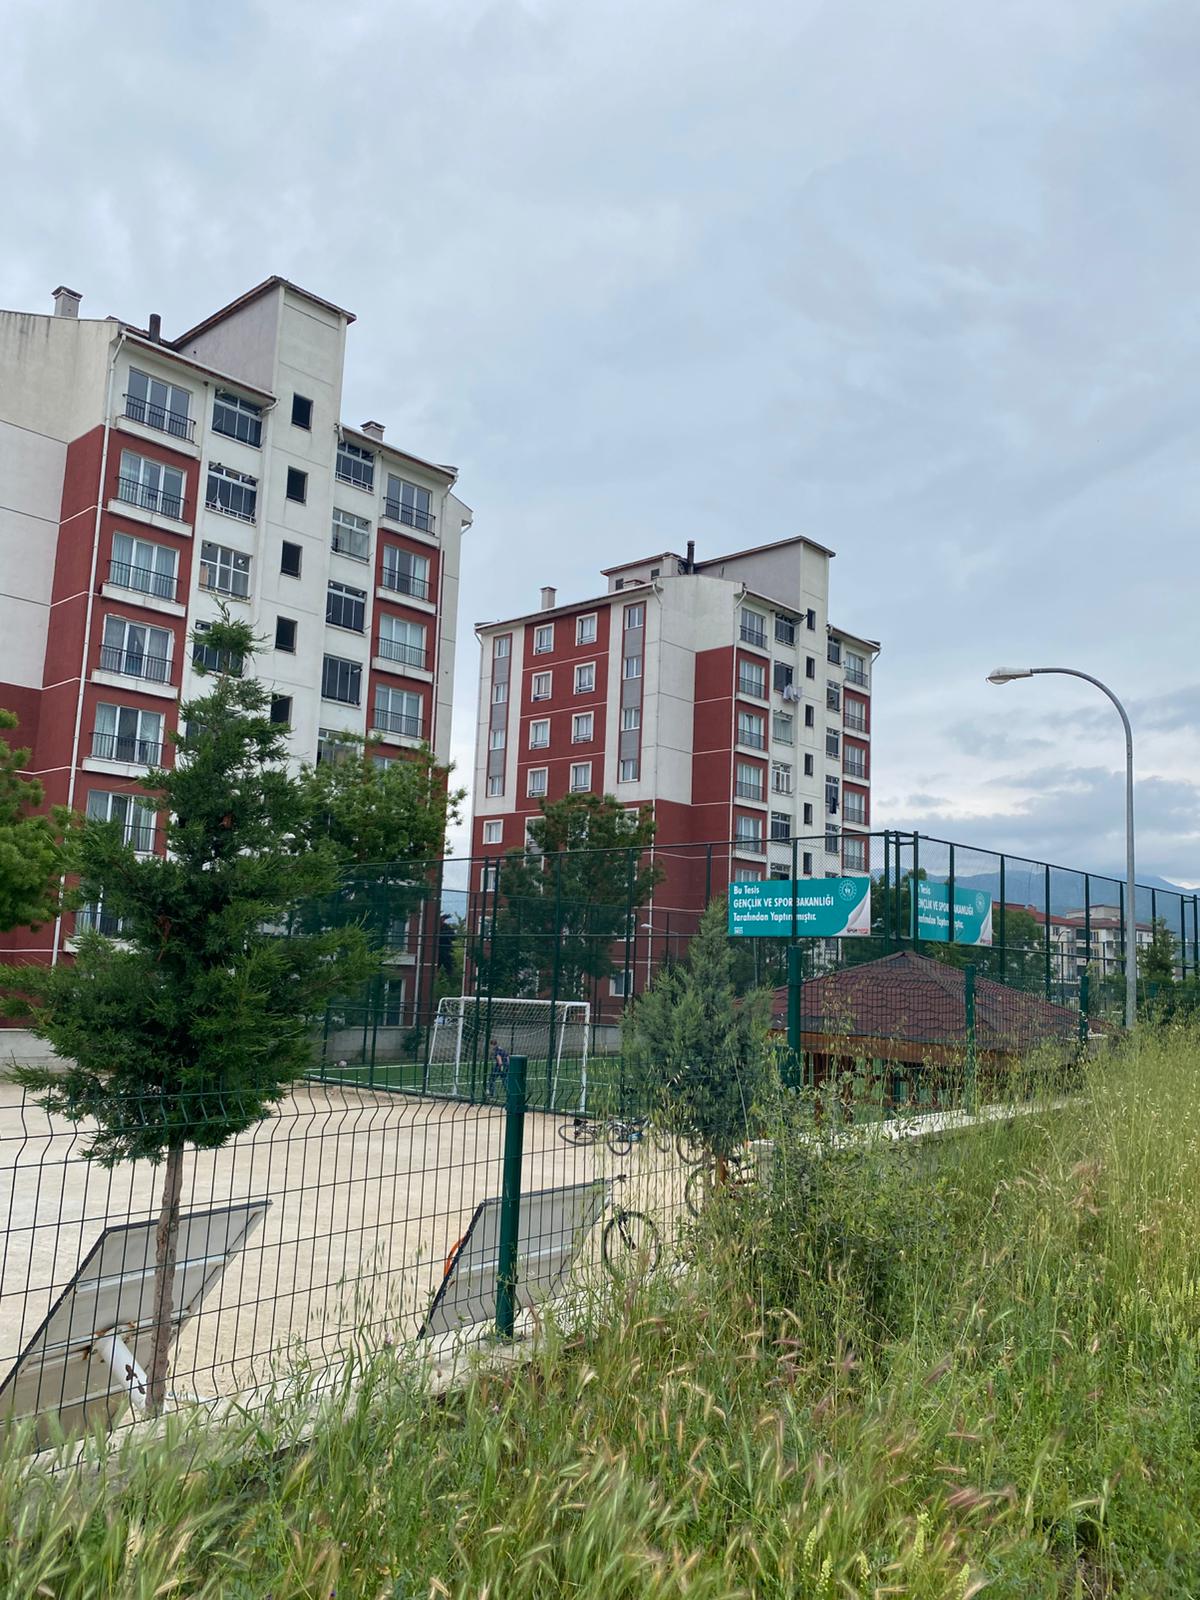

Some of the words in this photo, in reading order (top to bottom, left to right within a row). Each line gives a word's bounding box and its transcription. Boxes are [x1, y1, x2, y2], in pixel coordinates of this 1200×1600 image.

[733, 885, 743, 895] Bu
[744, 885, 760, 895] Tesis
[733, 896, 762, 910] GENÇLİK
[763, 898, 773, 908] VE
[774, 897, 793, 907] SPOR
[733, 911, 769, 922] Tarafından
